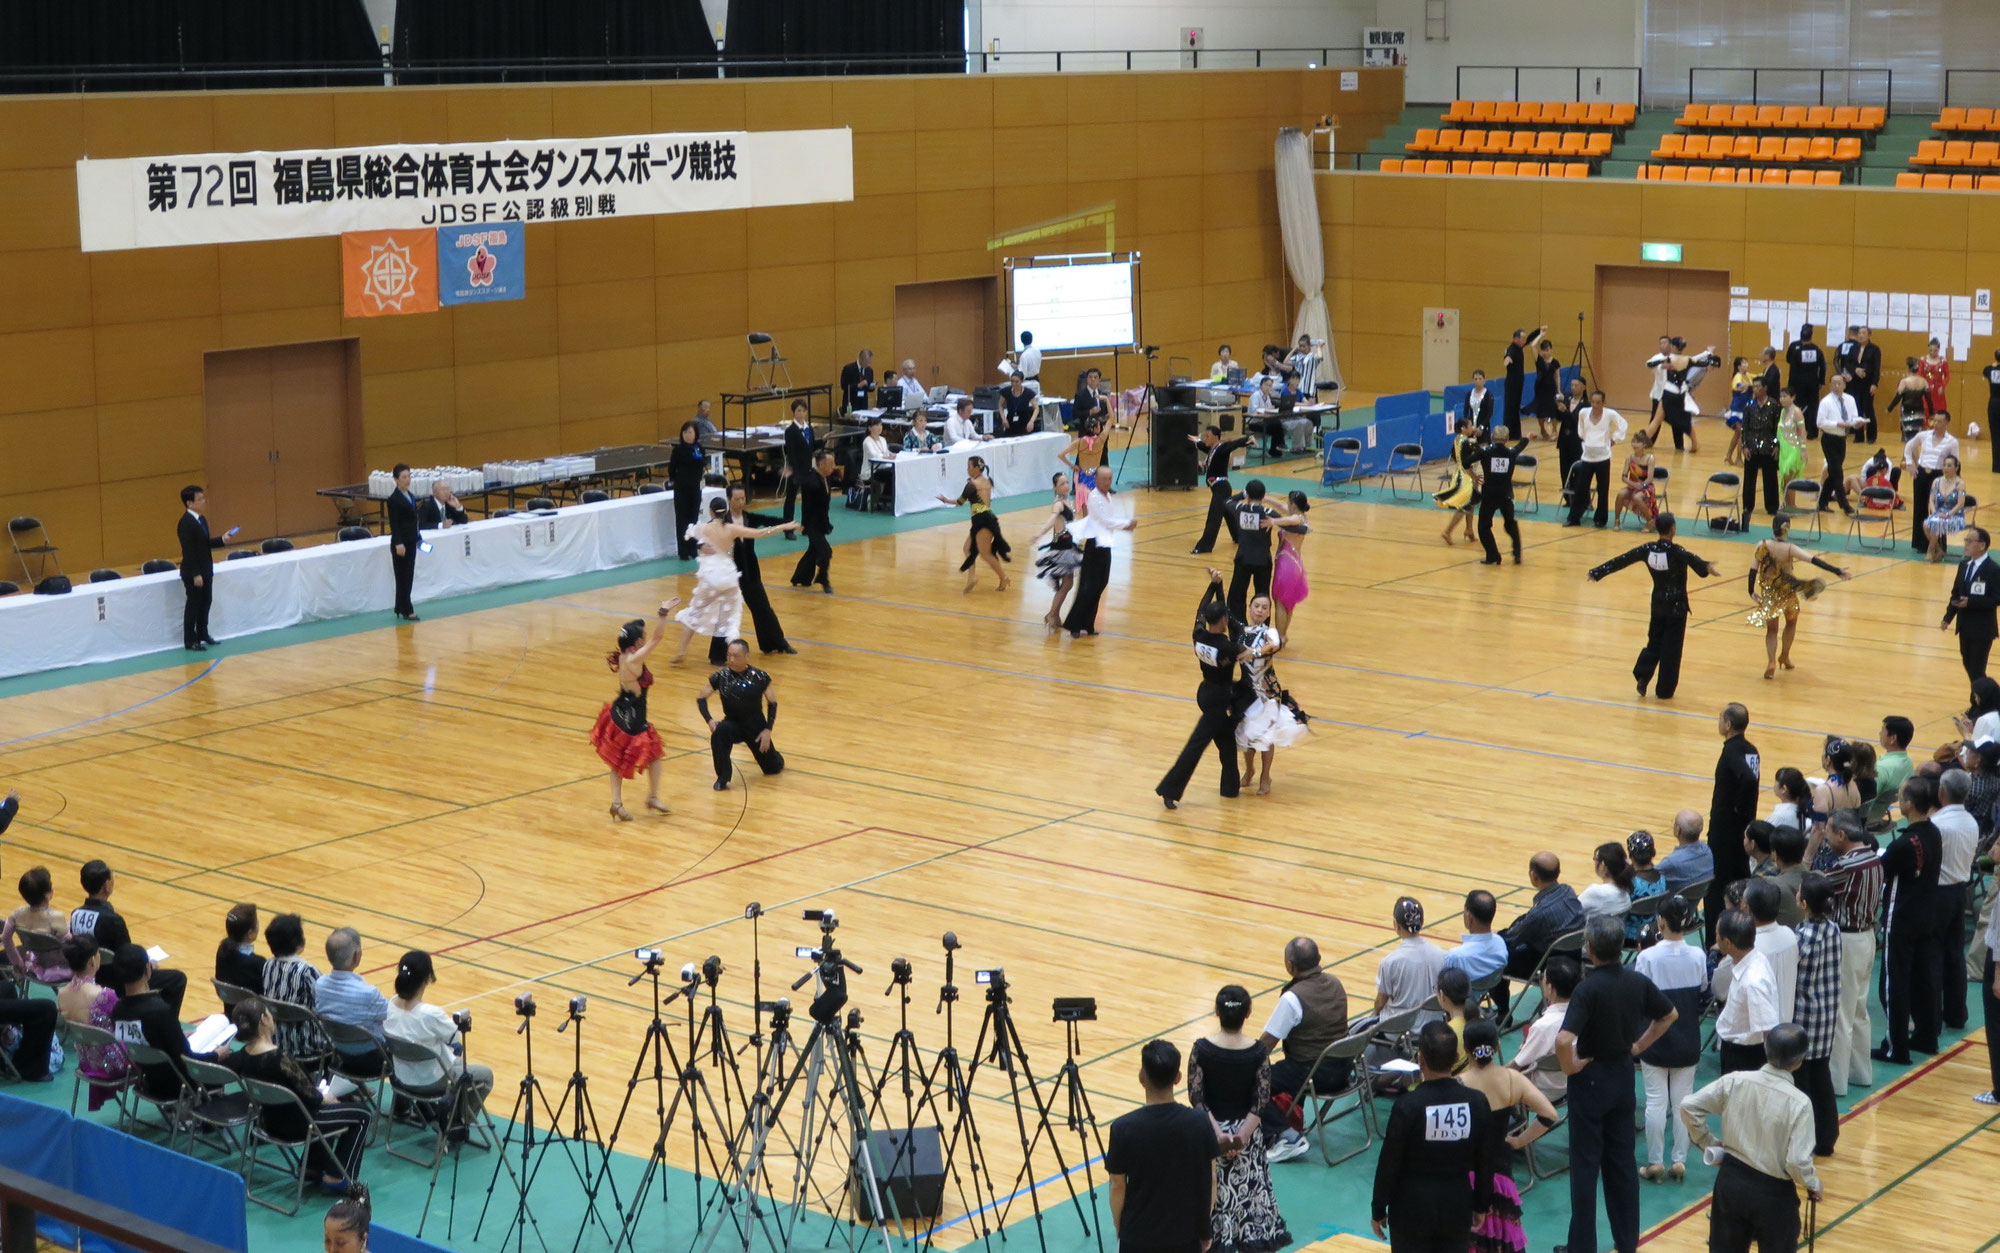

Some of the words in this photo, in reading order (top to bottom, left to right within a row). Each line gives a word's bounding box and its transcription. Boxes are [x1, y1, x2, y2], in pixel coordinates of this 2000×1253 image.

[146, 160, 258, 212] 第72回
[273, 139, 738, 205] 福島県総合体育大会ダンススポーツ競技
[421, 194, 616, 225] JDSF公認級別戦
[1495, 459, 1505, 468] 34
[1243, 513, 1255, 524] 32
[74, 912, 95, 929] 148
[1432, 1106, 1467, 1129] 145
